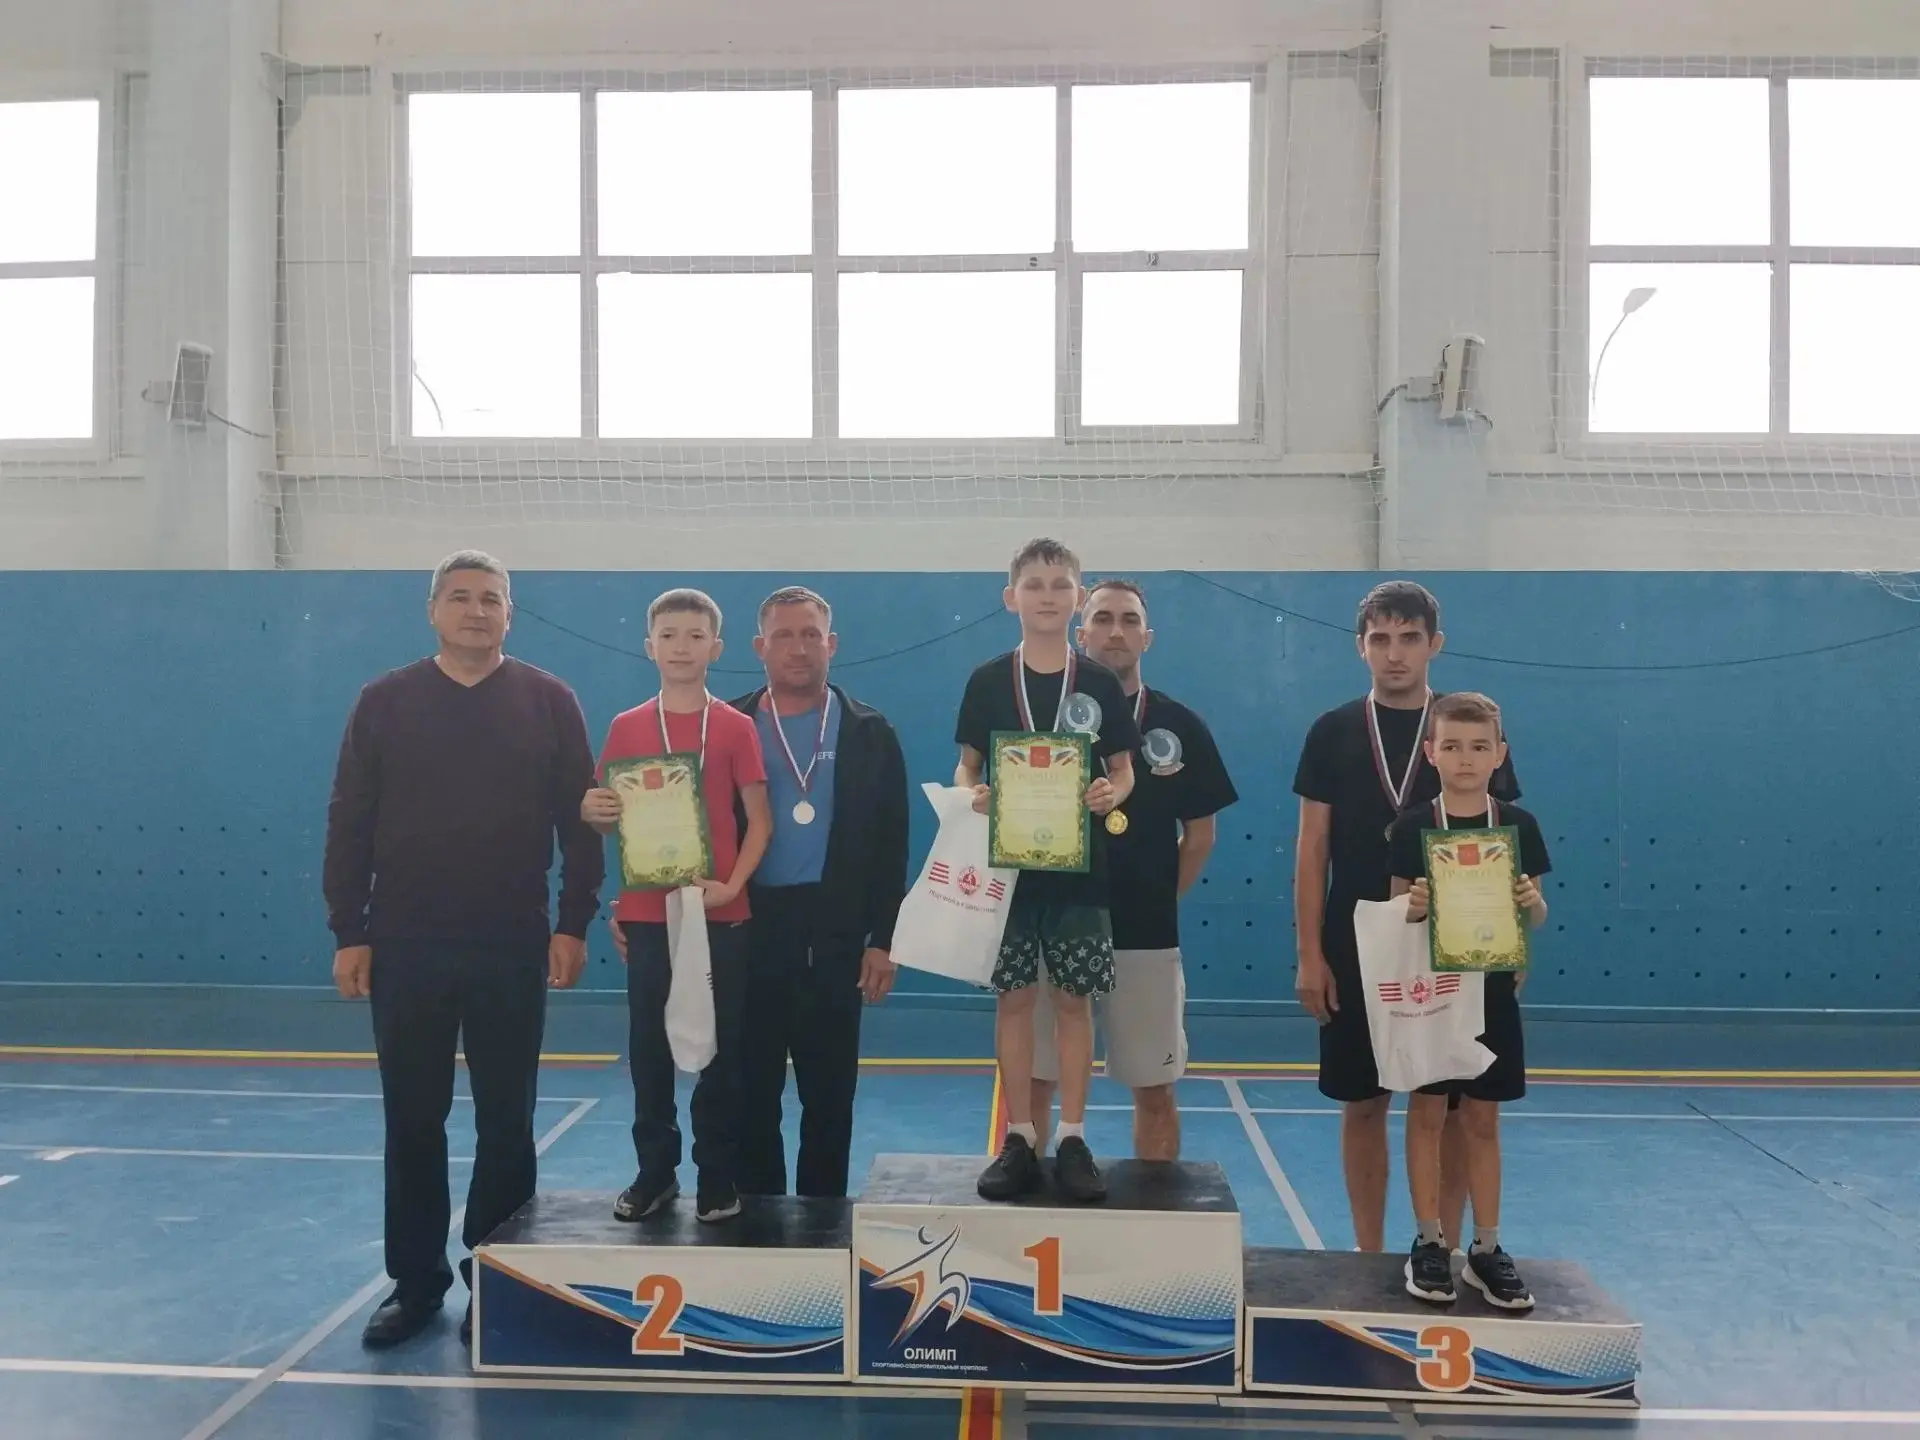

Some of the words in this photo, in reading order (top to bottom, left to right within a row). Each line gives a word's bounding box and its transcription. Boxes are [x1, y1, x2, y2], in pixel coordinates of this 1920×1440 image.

[1023, 1236, 1061, 1313] 1
[634, 1273, 684, 1353] 2
[904, 1347, 957, 1361] ОЛИМП
[1418, 1325, 1473, 1390] 3
